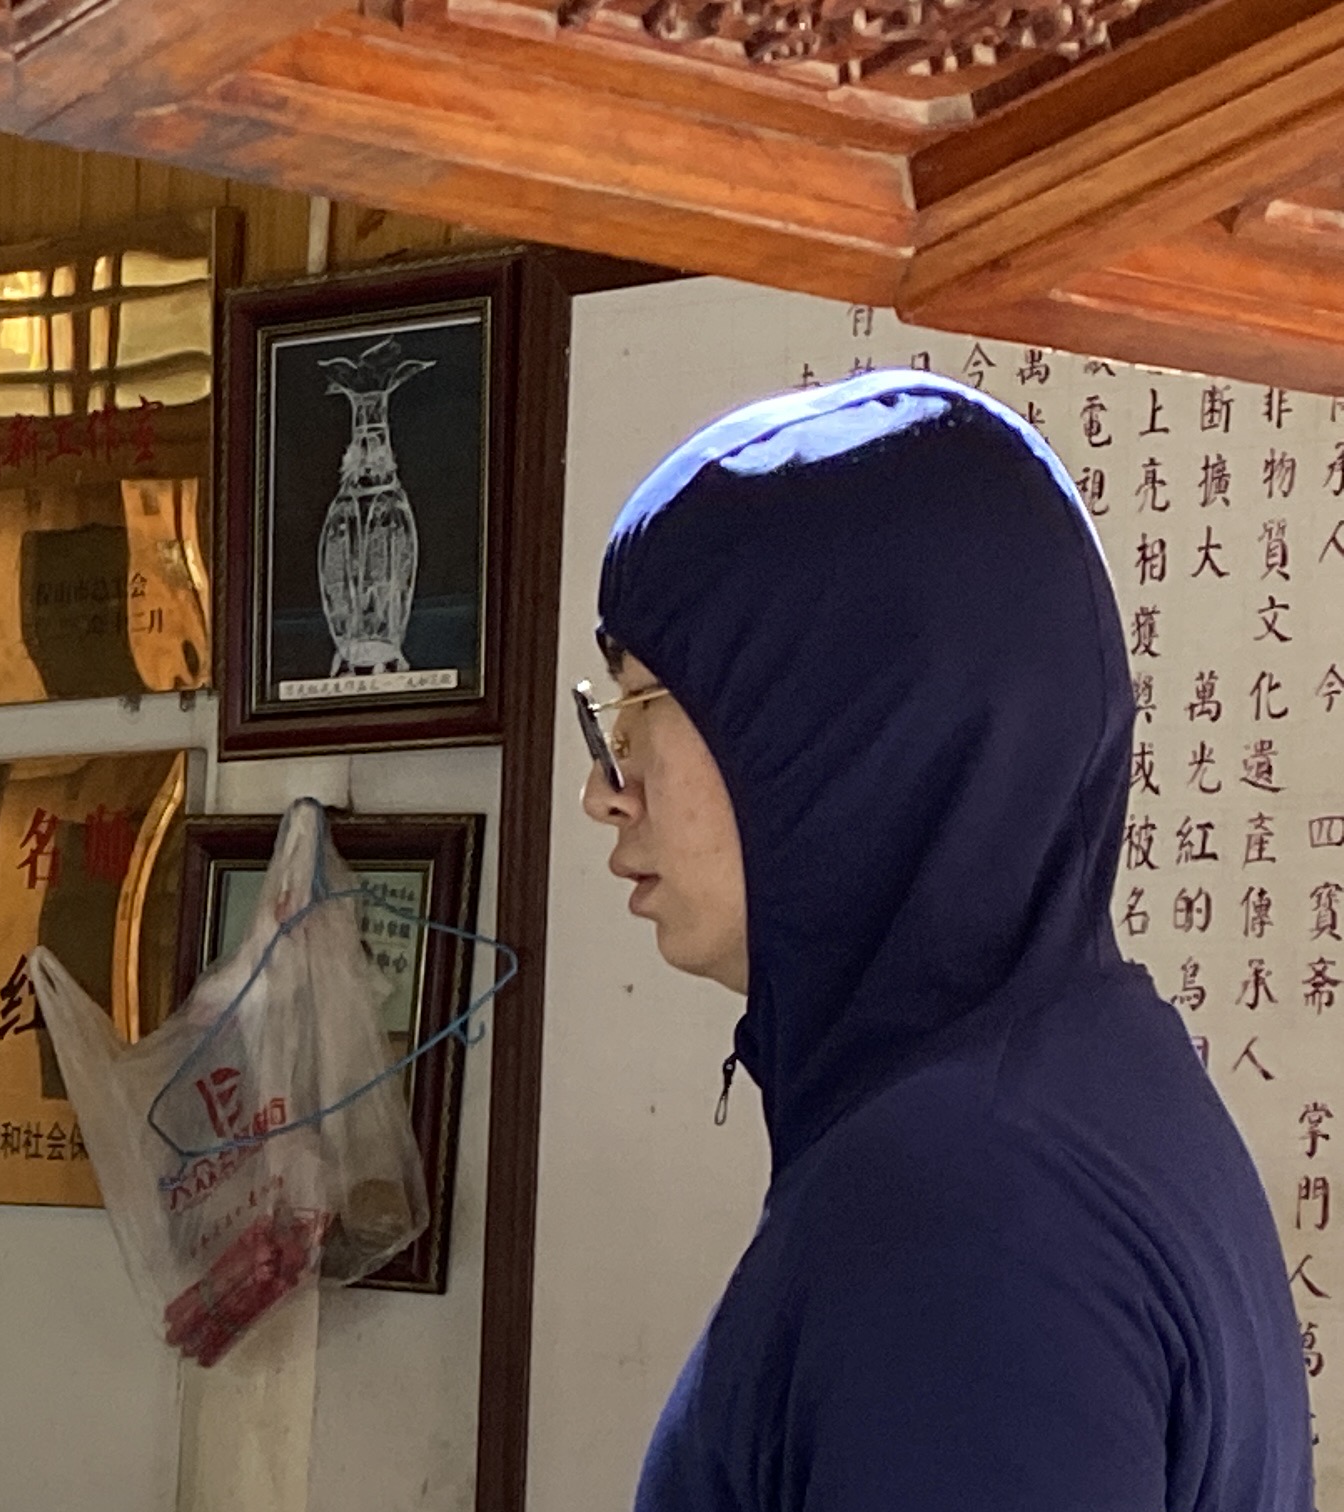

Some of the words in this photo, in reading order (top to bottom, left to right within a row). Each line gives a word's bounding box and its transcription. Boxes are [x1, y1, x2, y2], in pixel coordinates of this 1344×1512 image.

[1076, 359, 1116, 516] 電視
[1171, 670, 1222, 1068] 萬光紅的烏
